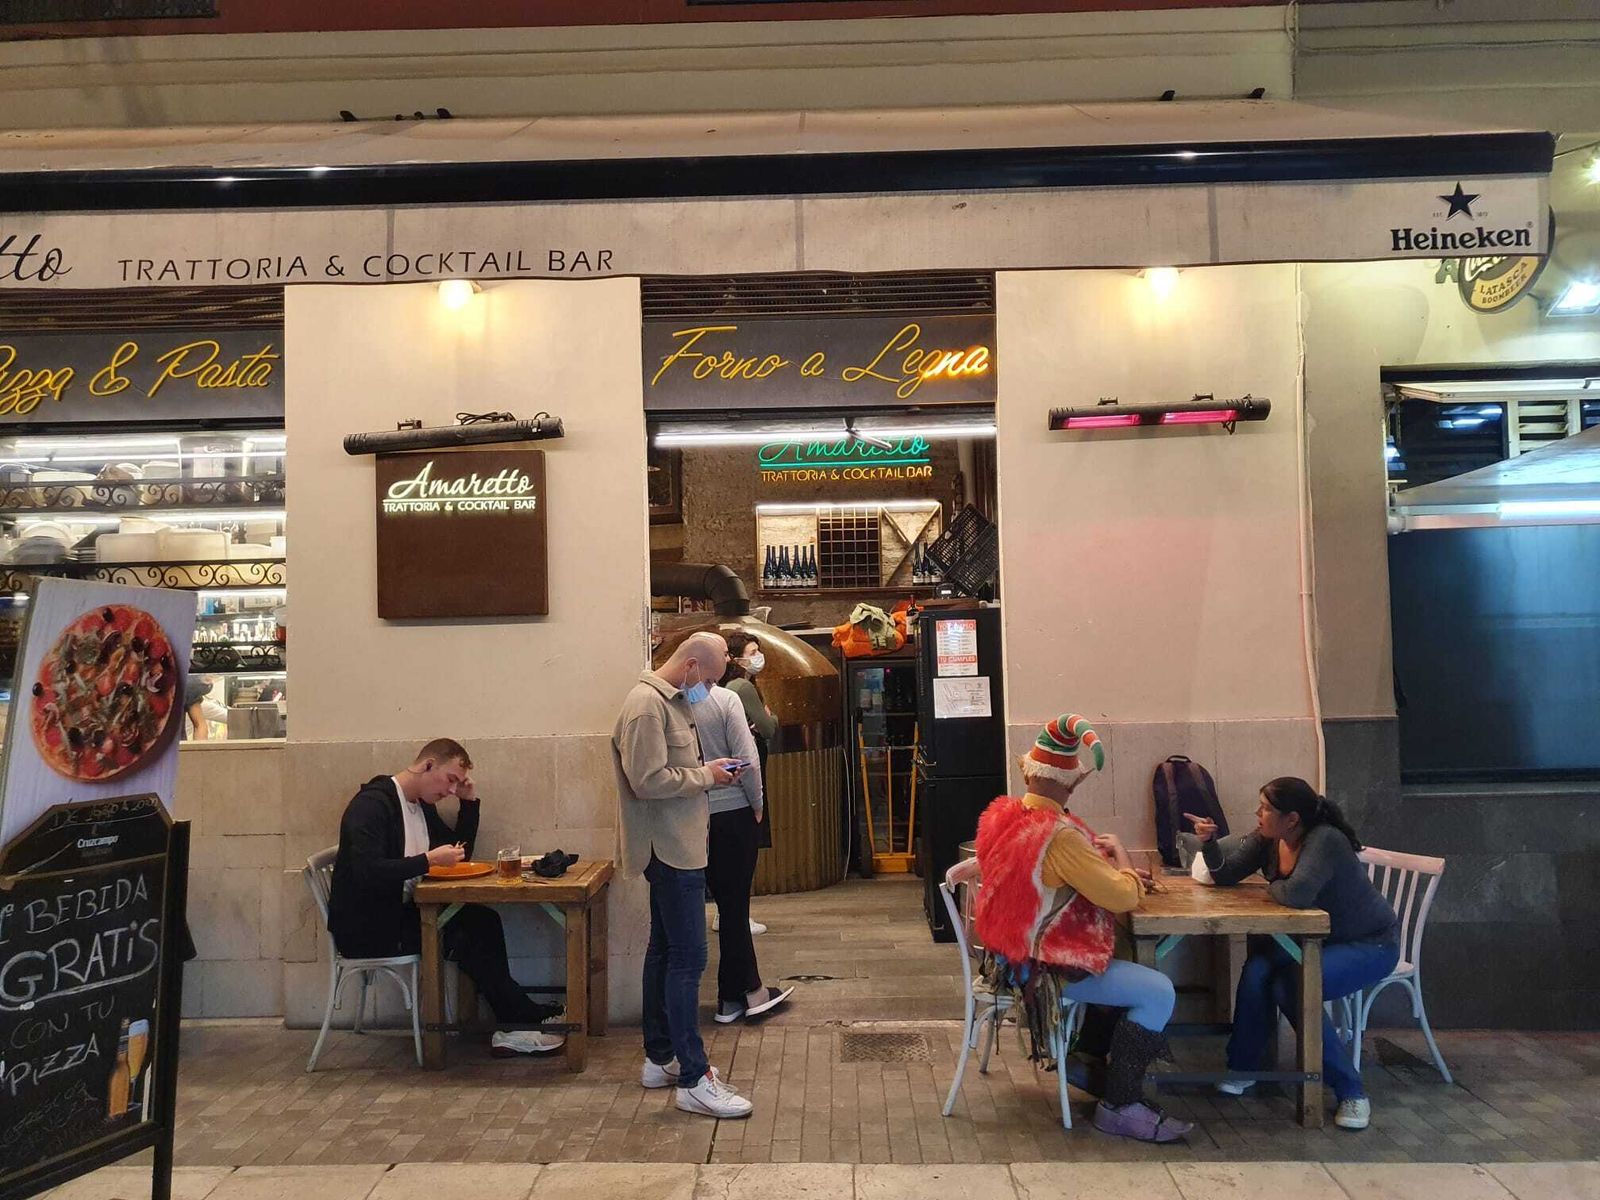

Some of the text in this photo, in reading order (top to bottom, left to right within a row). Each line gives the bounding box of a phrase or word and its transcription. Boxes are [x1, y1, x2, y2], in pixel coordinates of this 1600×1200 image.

[1390, 226, 1532, 251] Heineken
[118, 255, 308, 281] TRATTORIA
[325, 254, 346, 277] &
[363, 249, 531, 277] COCKTAIL
[548, 249, 614, 272] BAR
[89, 341, 139, 396] &
[147, 340, 280, 398] Pasta
[651, 323, 989, 399] Forno a Legna
[387, 461, 534, 499] Amaretto
[761, 465, 933, 482] TRATTORIA & COCKTAIL BAR
[383, 499, 536, 513] TRATTORIA & COCKTAIL BAR
[23, 873, 149, 934] BEBIDA
[10, 995, 115, 1050] CON TU
